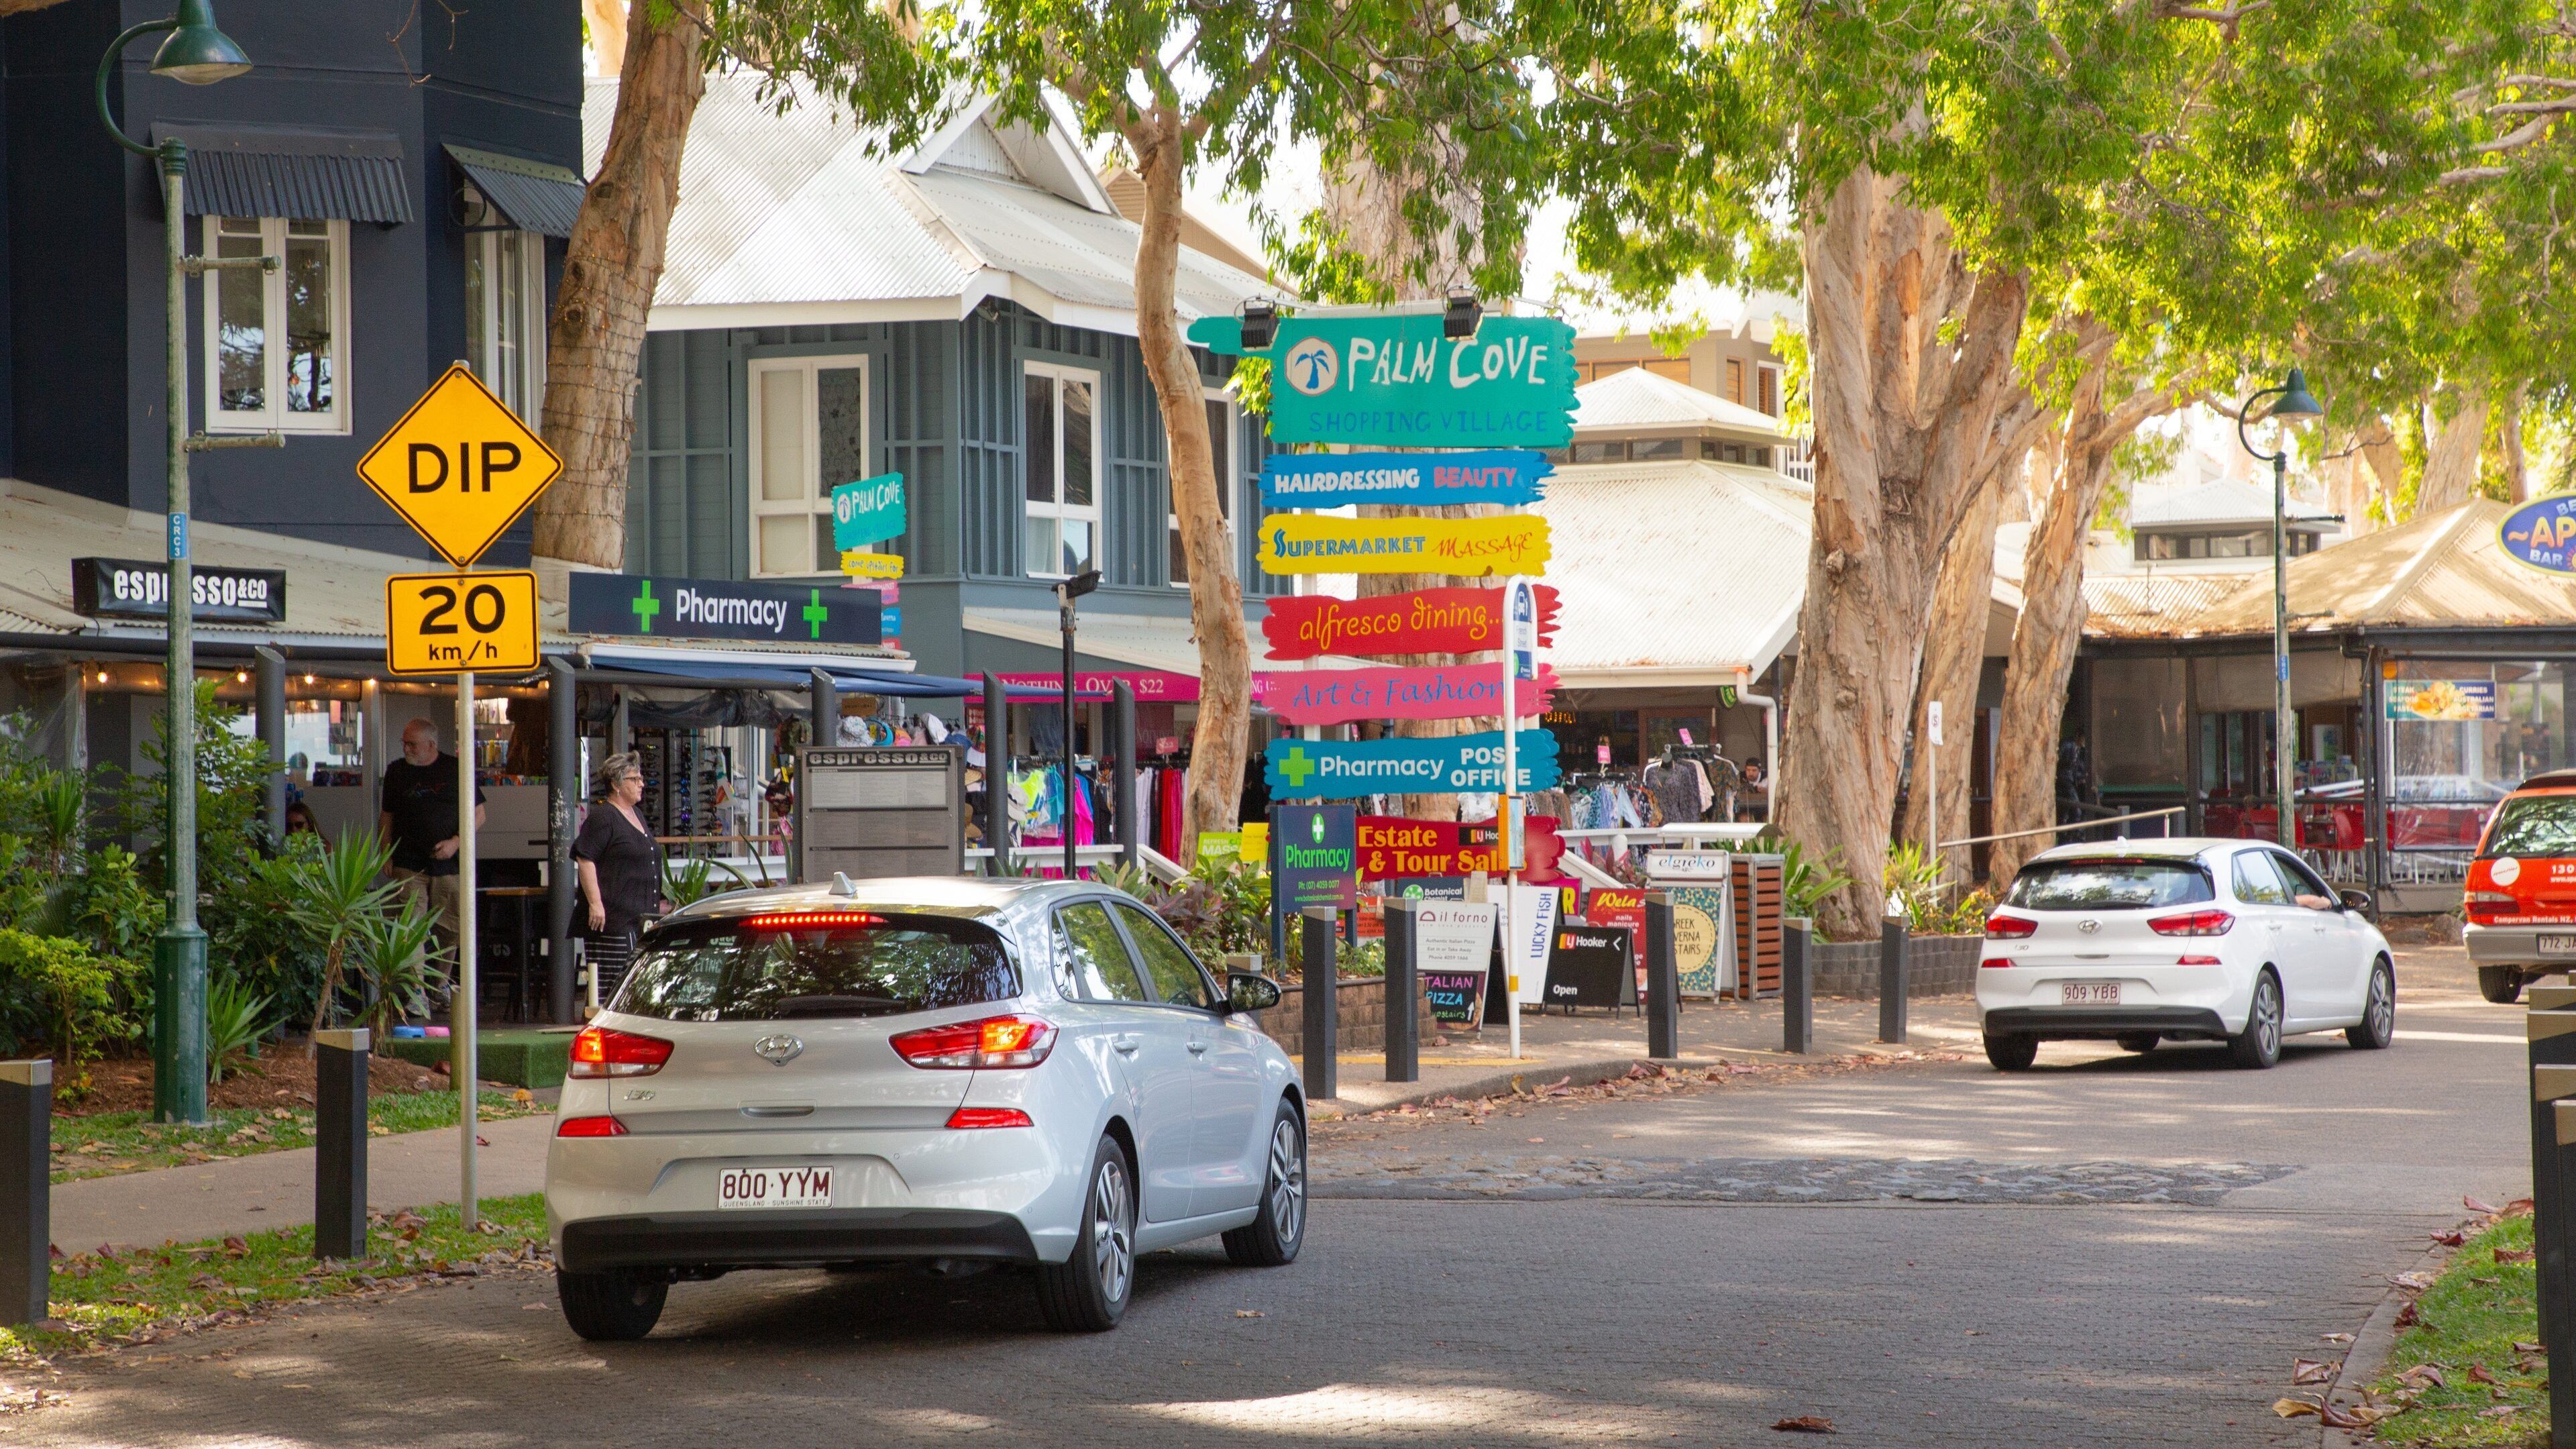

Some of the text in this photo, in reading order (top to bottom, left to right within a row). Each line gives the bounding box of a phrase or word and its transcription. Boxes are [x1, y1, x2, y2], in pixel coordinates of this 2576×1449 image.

[1348, 336, 1548, 392] PALM COVE
[1309, 410, 1548, 433] SHOPPING VILLAGE
[408, 441, 521, 494] DIP
[1275, 467, 1518, 494] HAIRDRESSING BEAUTY
[853, 480, 900, 519] PALM COVE
[1273, 528, 1533, 562] SUPERMARKET MASSAGE
[849, 559, 864, 569] come
[2530, 549, 2563, 566] BAR
[114, 570, 267, 606] espsso&CO
[419, 584, 505, 635] 20
[676, 588, 788, 633] Pharmacy
[1300, 604, 1401, 650] alfresco
[429, 640, 498, 661] km/h
[1139, 679, 1164, 694] $22
[1293, 684, 1344, 708] Art
[1350, 680, 1373, 706] &
[1320, 755, 1444, 780] Pharmacy
[1450, 768, 1531, 787] OFFIE
[1358, 825, 1438, 847] Estate
[1286, 844, 1350, 872] Pharmacy
[1368, 851, 1386, 873] &
[1392, 850, 1452, 872] Tour
[1424, 887, 1462, 896] Botanical
[1440, 911, 1448, 922] il
[1453, 912, 1488, 923] forno
[1674, 918, 1695, 929] REEK
[1530, 922, 1547, 958] LUCKY
[1576, 936, 1607, 948] Hooker
[1674, 931, 1701, 943] VERNA
[1424, 975, 1473, 989] TALIAN
[1553, 985, 1578, 996] Open
[723, 1199, 765, 1208] QUEENSLAND
